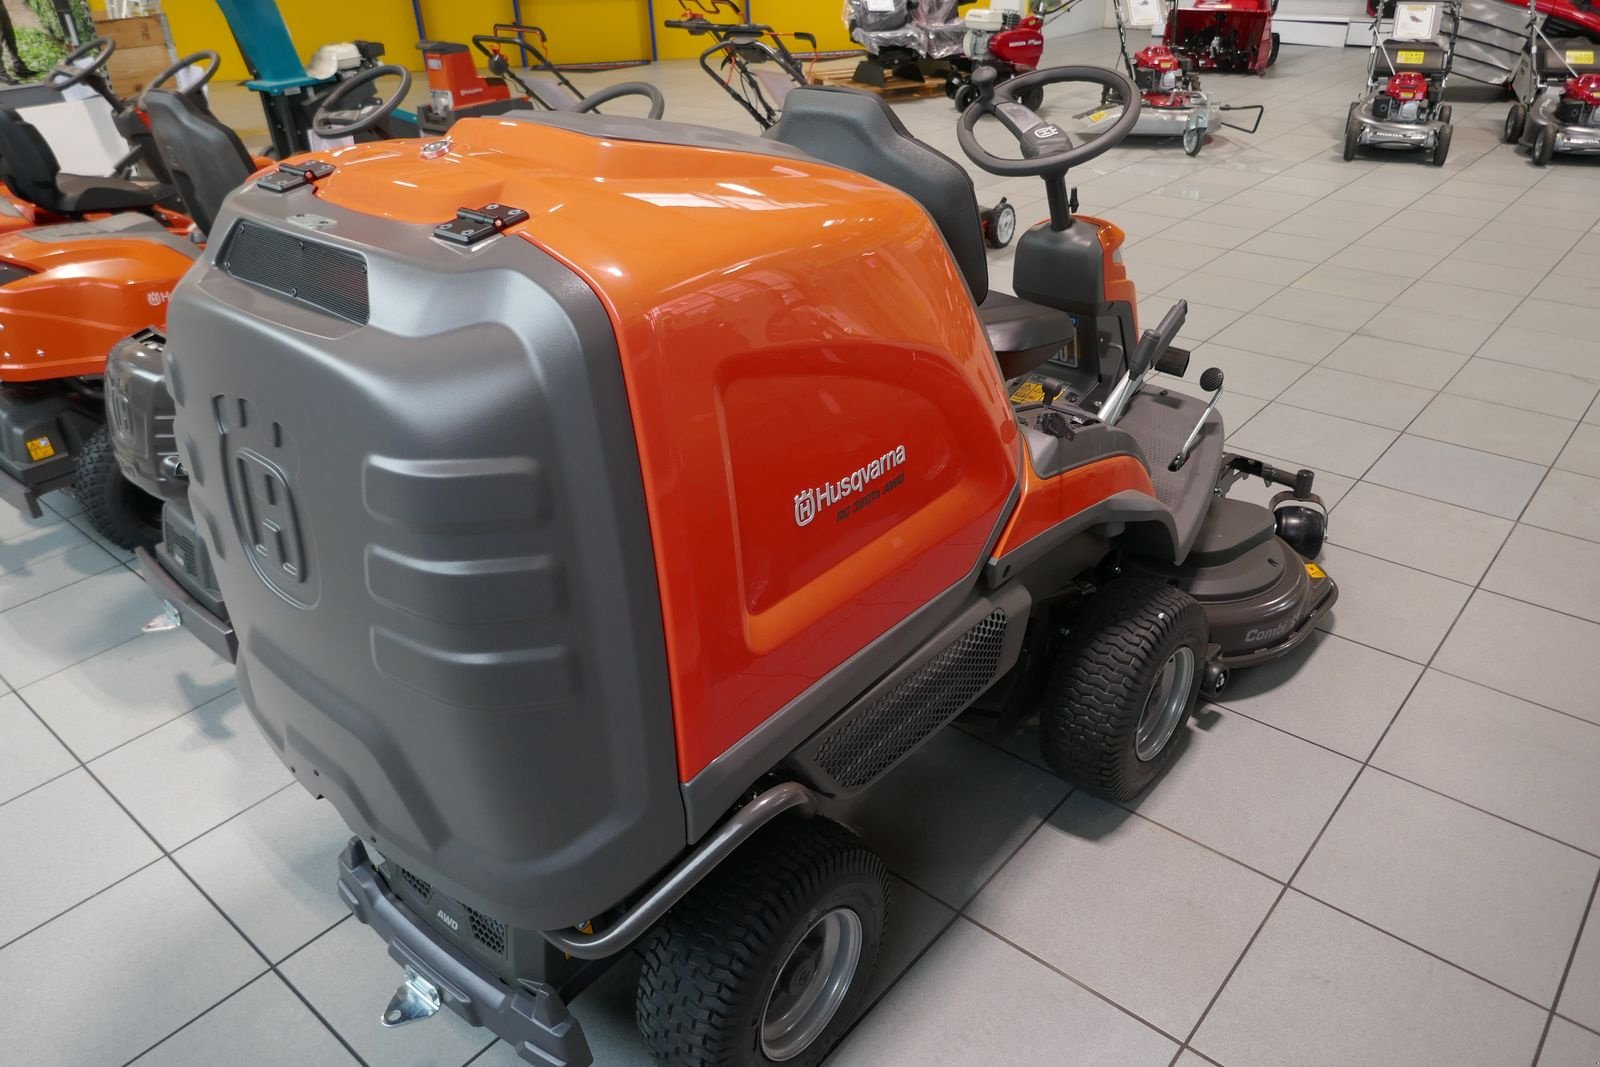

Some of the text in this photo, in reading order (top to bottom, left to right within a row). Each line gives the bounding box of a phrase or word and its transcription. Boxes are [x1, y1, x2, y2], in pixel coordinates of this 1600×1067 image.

[816, 445, 905, 512] Husqvarna
[1245, 622, 1286, 642] Combi
[437, 909, 459, 931] AWD
